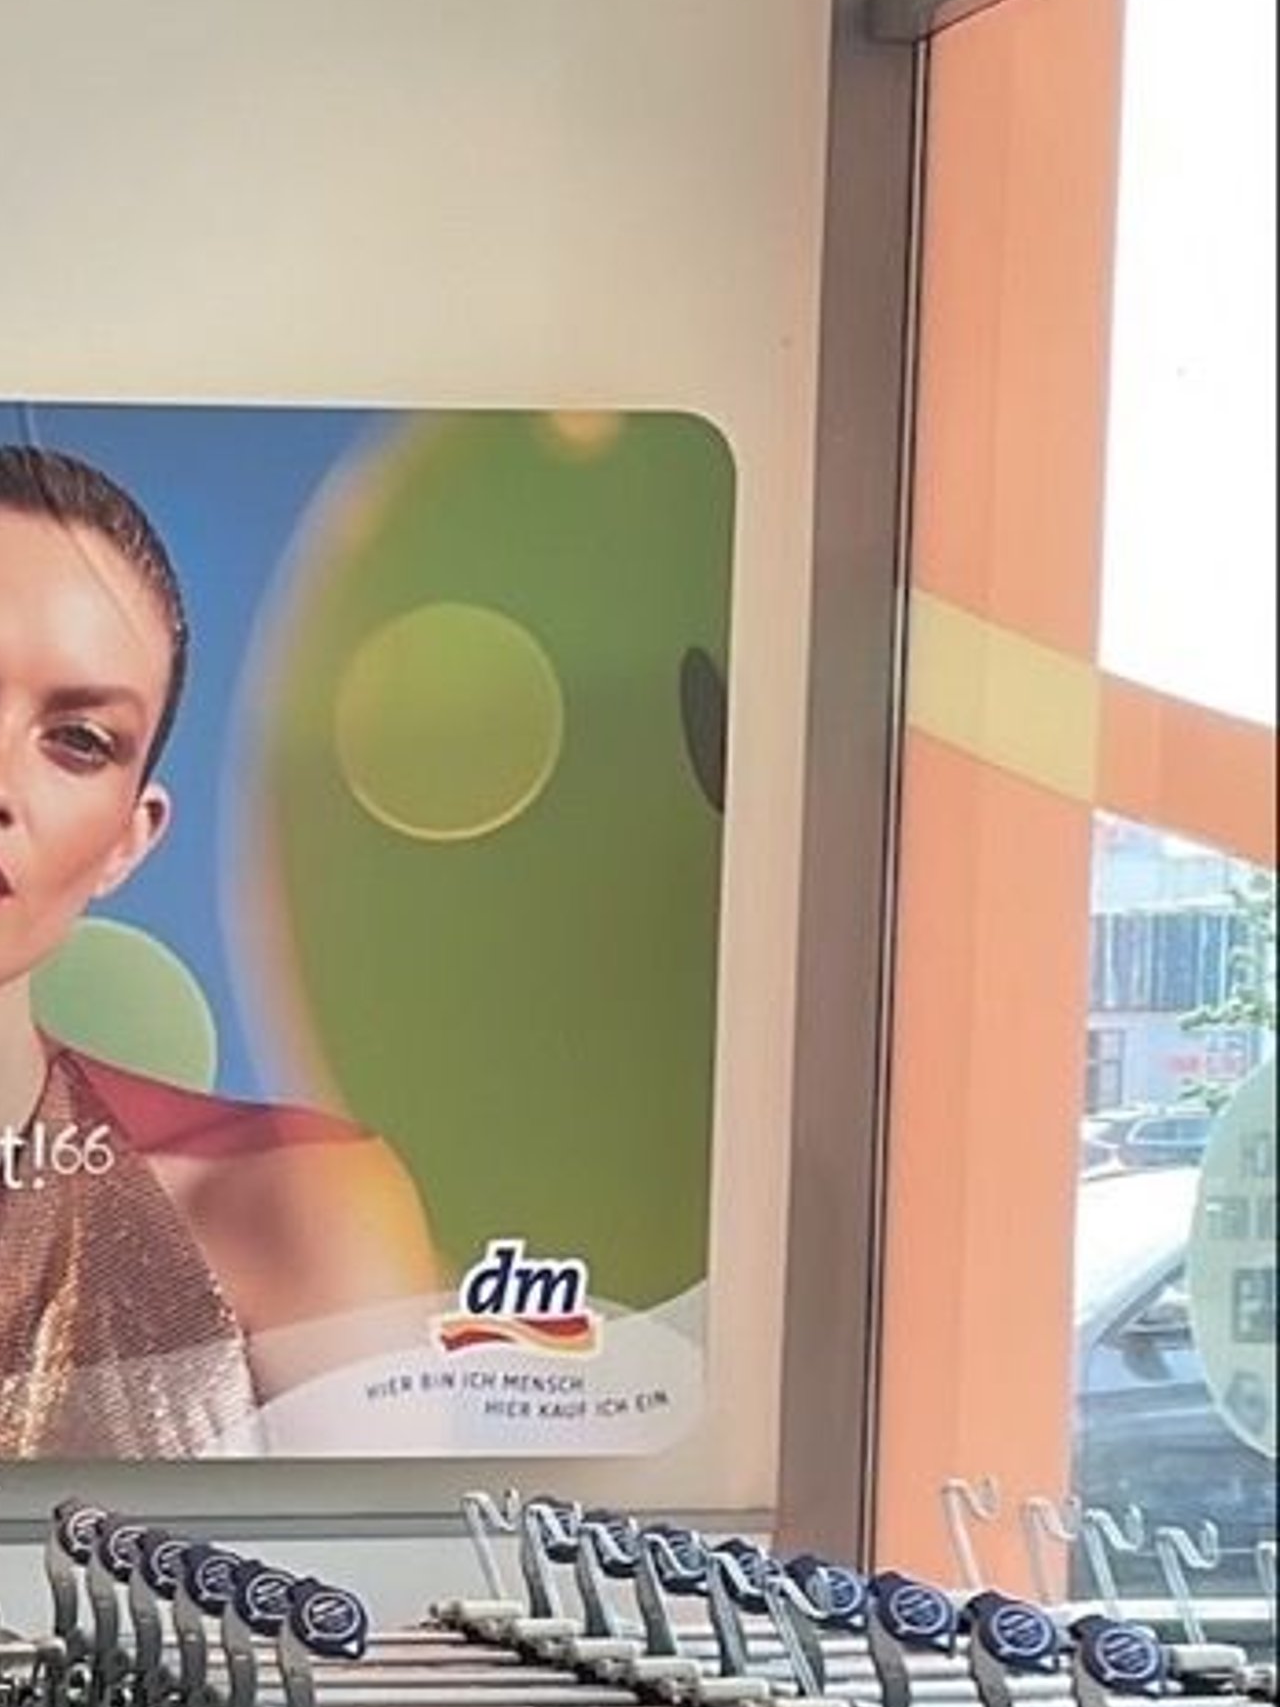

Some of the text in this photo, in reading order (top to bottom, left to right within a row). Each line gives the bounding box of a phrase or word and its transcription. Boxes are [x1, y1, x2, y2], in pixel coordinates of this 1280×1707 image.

[467, 1247, 580, 1314] dm
[366, 1371, 584, 1399] HIER BIN ICH MENSCH
[485, 1390, 669, 1418] HIER KAUF ICH EIN
